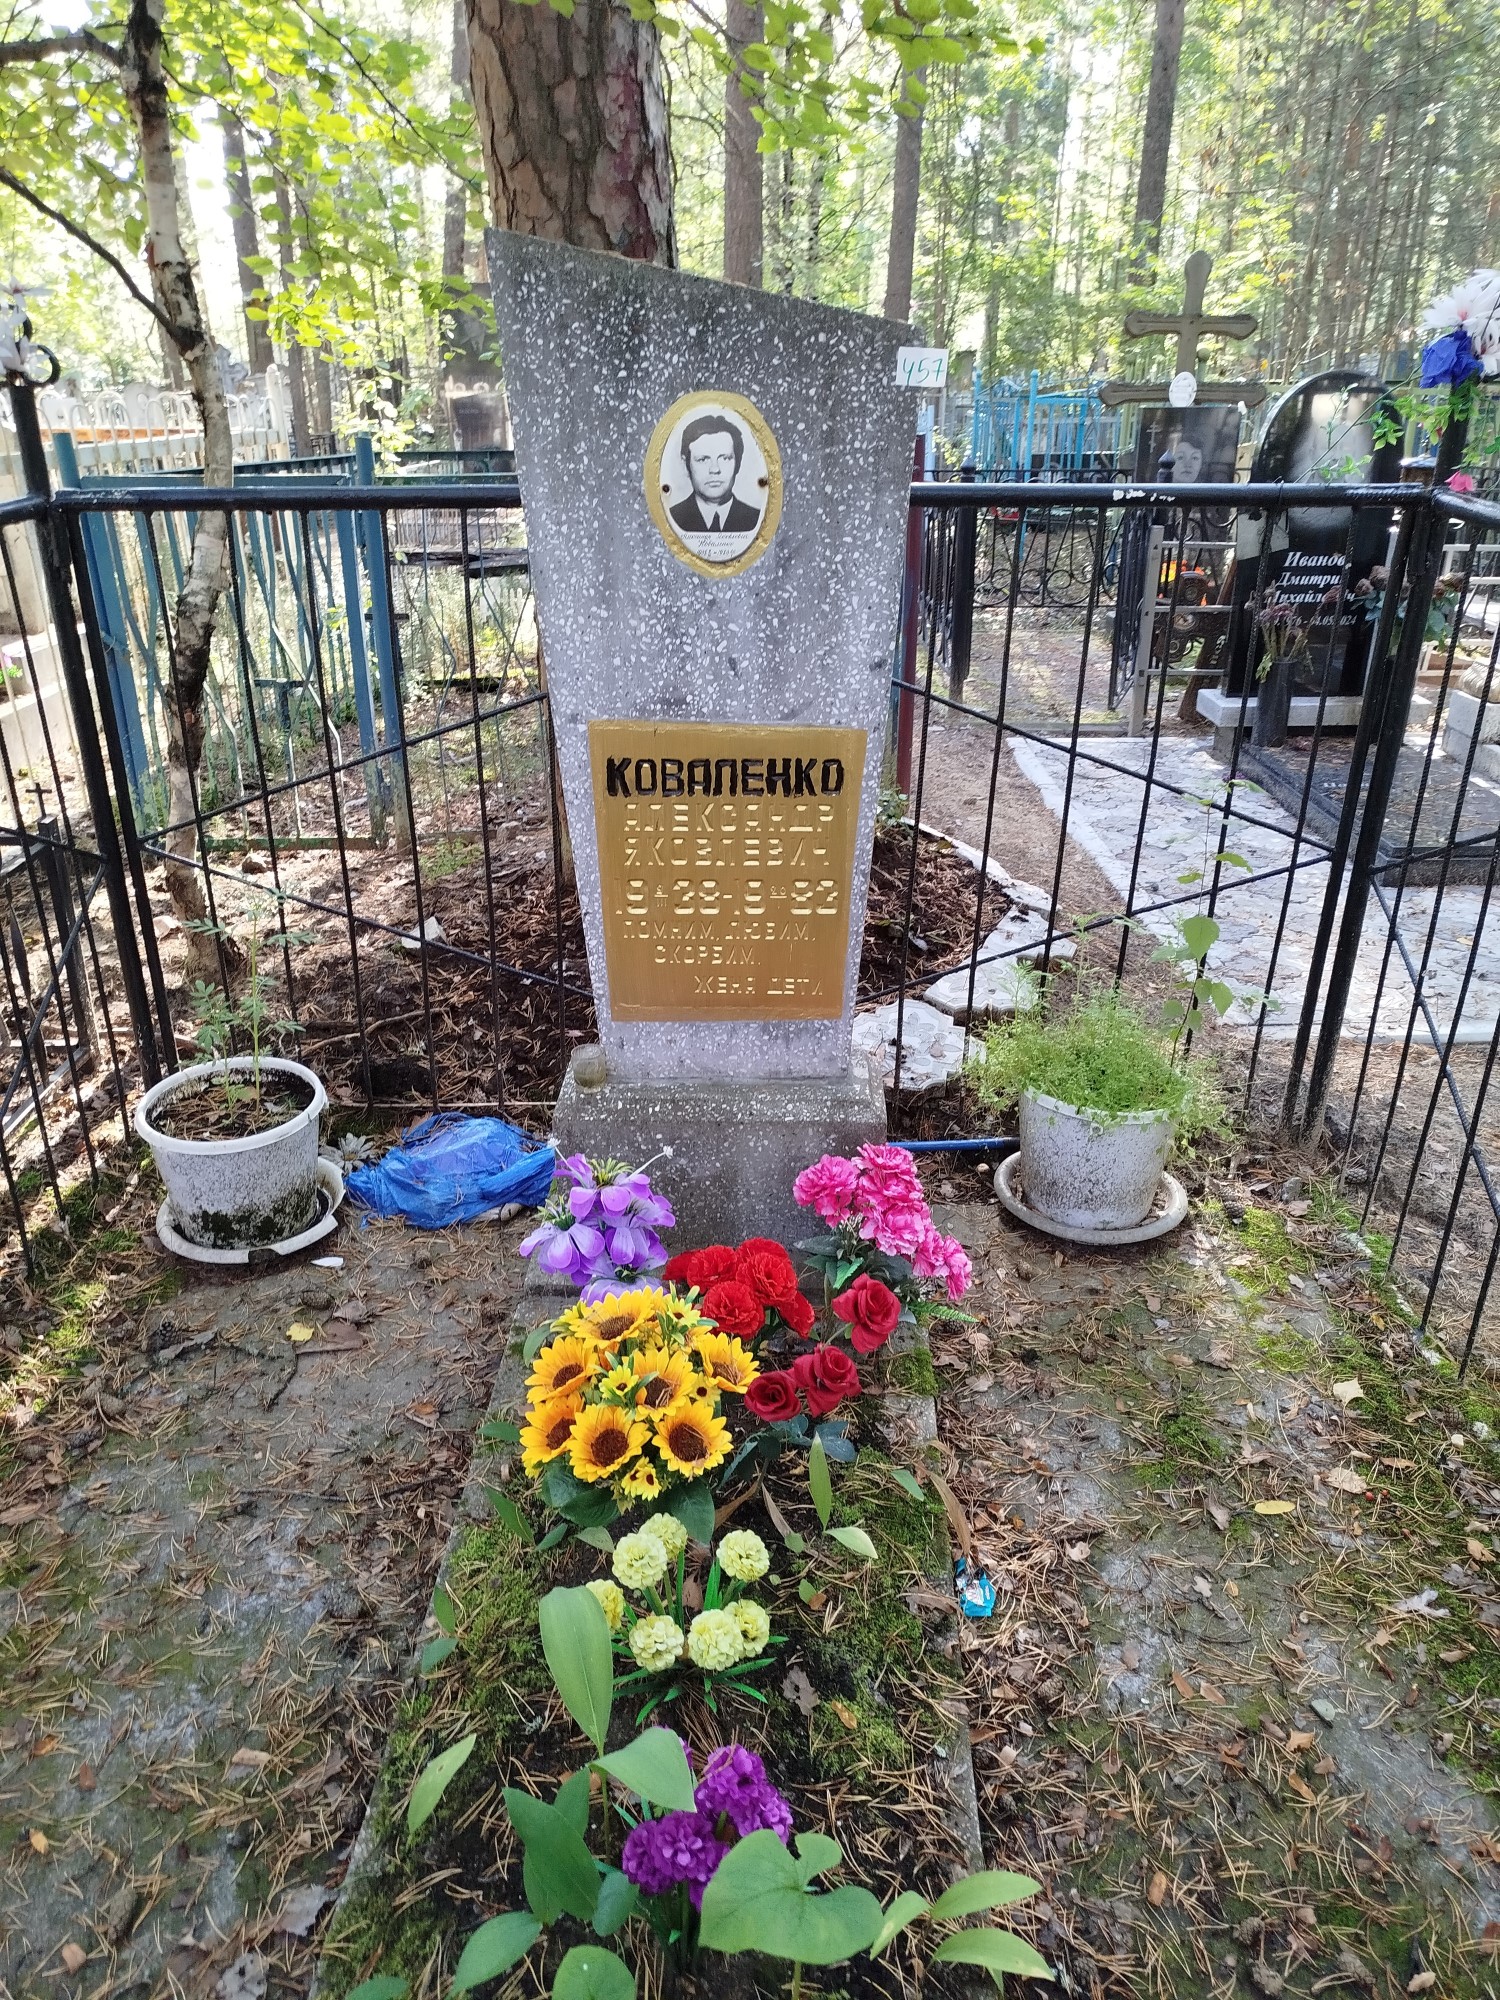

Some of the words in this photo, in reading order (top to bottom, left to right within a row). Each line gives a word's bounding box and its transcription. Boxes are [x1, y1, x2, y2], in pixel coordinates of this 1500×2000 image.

[902, 356, 945, 385] 457
[1276, 571, 1343, 588] Дмитри
[606, 756, 845, 798] КОВАЛЕНКО
[623, 803, 834, 832] АЛЕКСАНДР
[623, 838, 831, 866] ЯКОВЛЕВИЧ
